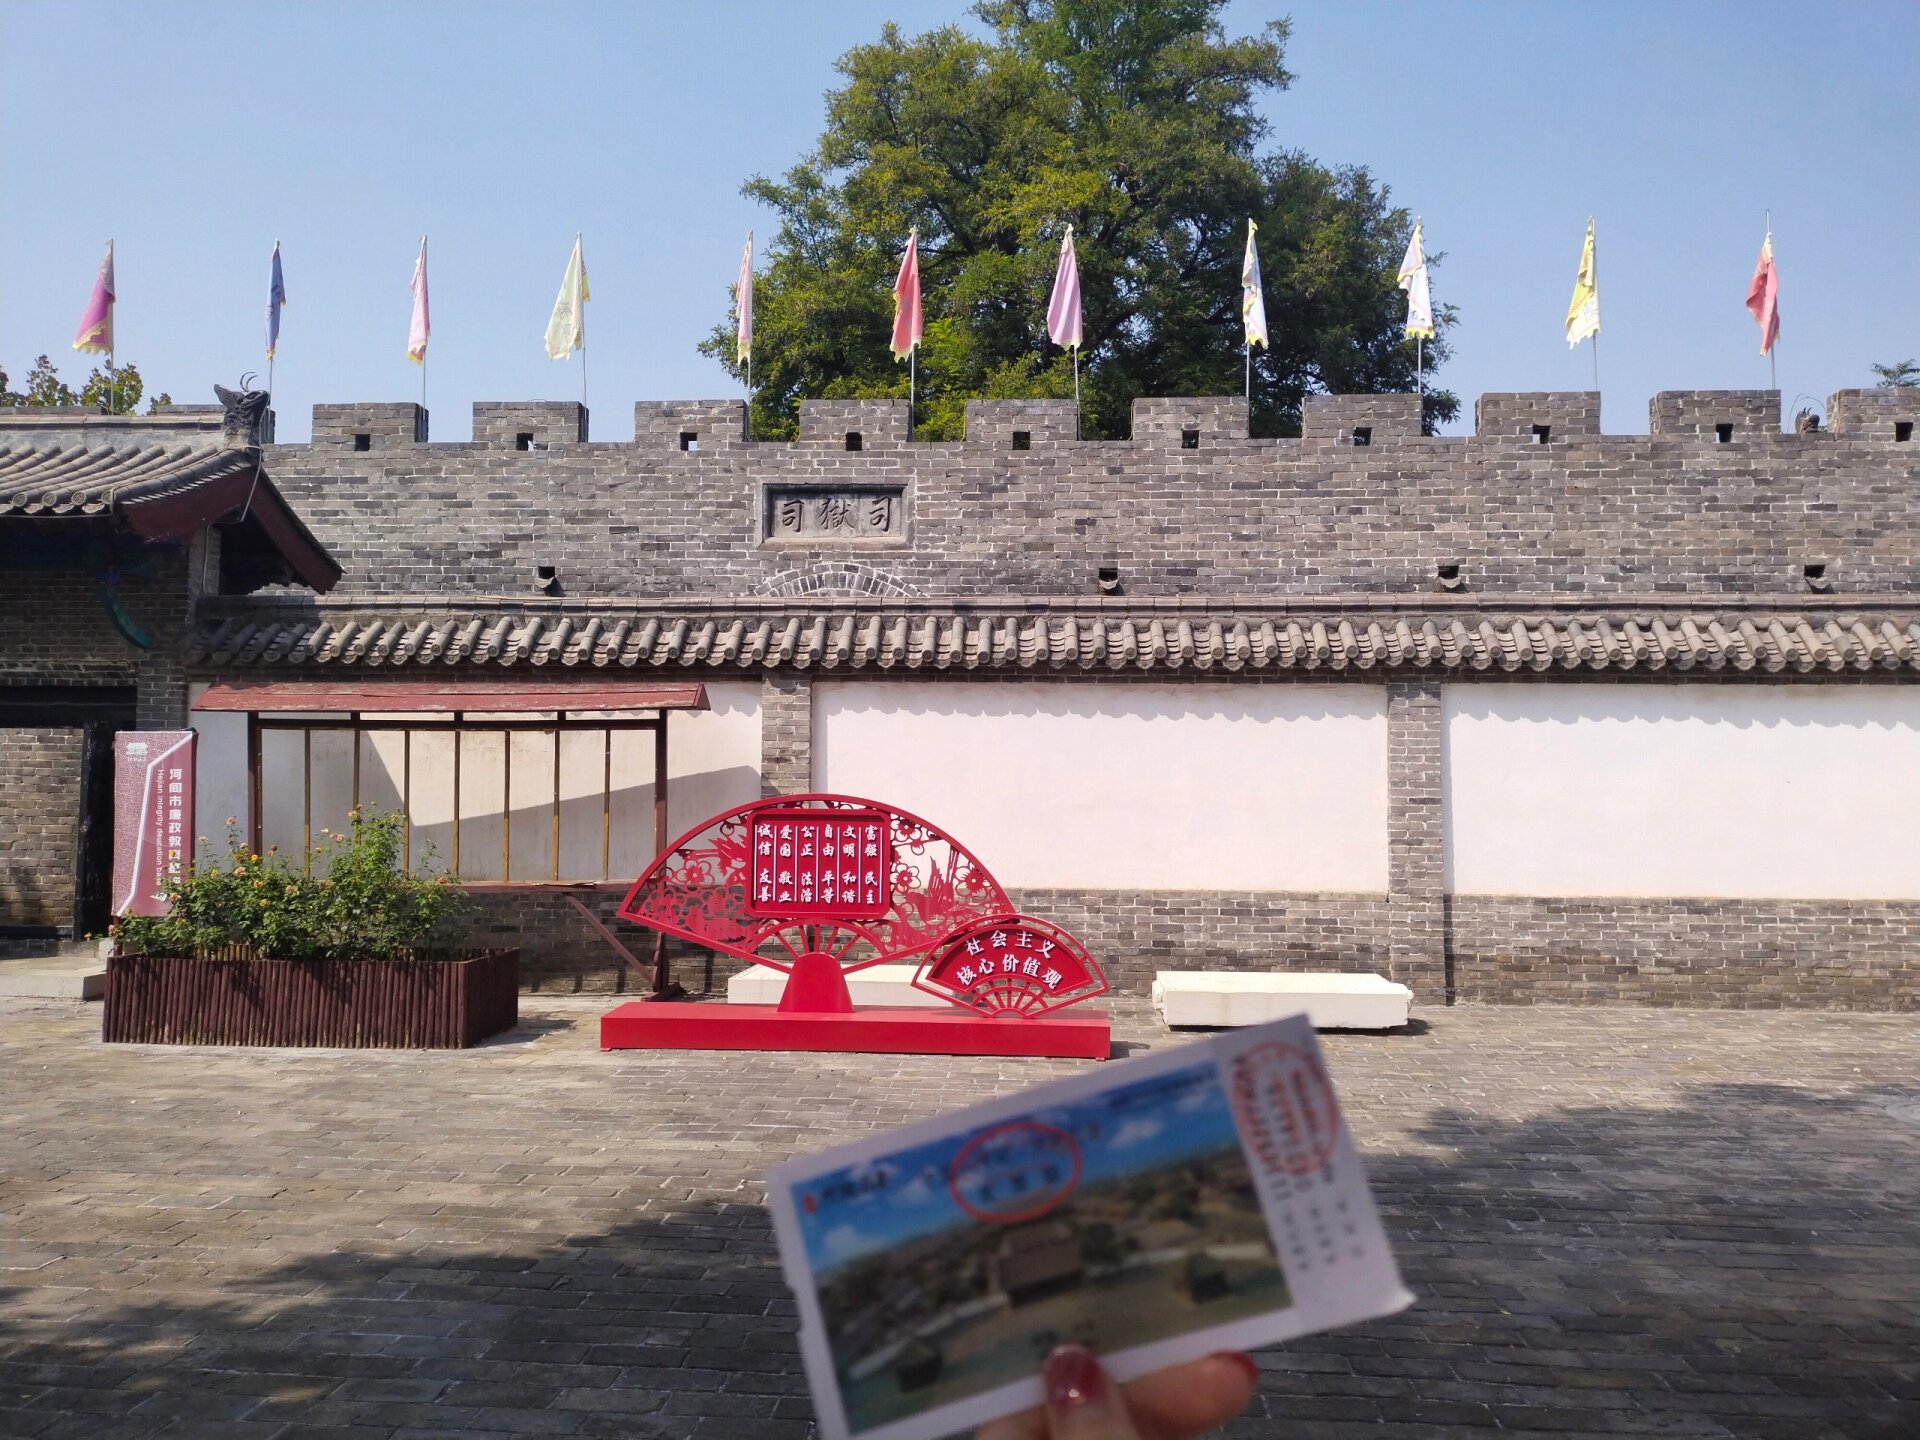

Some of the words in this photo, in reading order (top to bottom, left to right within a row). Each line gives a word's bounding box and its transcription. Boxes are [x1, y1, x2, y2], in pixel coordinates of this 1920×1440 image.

[155, 796, 164, 827] integrity
[758, 824, 773, 856] 诚信
[780, 825, 792, 857] 爱国
[801, 826, 814, 857] 公正
[822, 824, 835, 857] 自由
[842, 825, 856, 857] 文明
[864, 825, 878, 857] 富强
[758, 868, 773, 902] 友善
[779, 871, 793, 902] 敬业
[801, 872, 813, 903] 法治
[821, 870, 835, 904] 平等
[842, 872, 856, 903] 和谐
[864, 871, 878, 904] 民主
[965, 930, 1056, 959] 社会主义
[956, 954, 1063, 989] 核心价值观
